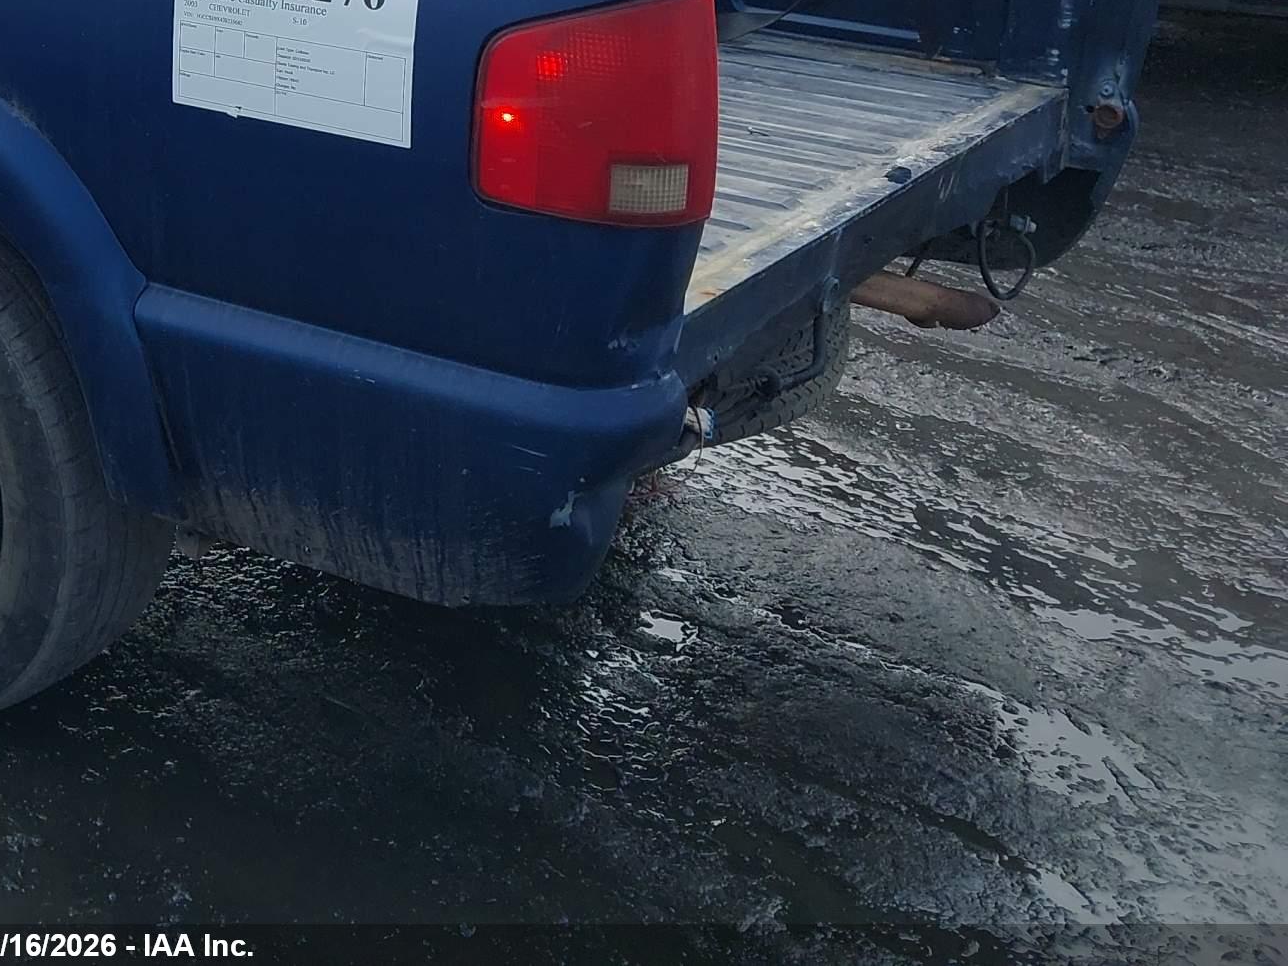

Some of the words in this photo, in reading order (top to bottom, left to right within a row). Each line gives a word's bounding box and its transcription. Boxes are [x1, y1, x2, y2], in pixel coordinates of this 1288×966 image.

[209, 3, 251, 17] CHEVROLET
[292, 17, 308, 26] S-10
[281, 0, 327, 16] Insurance
